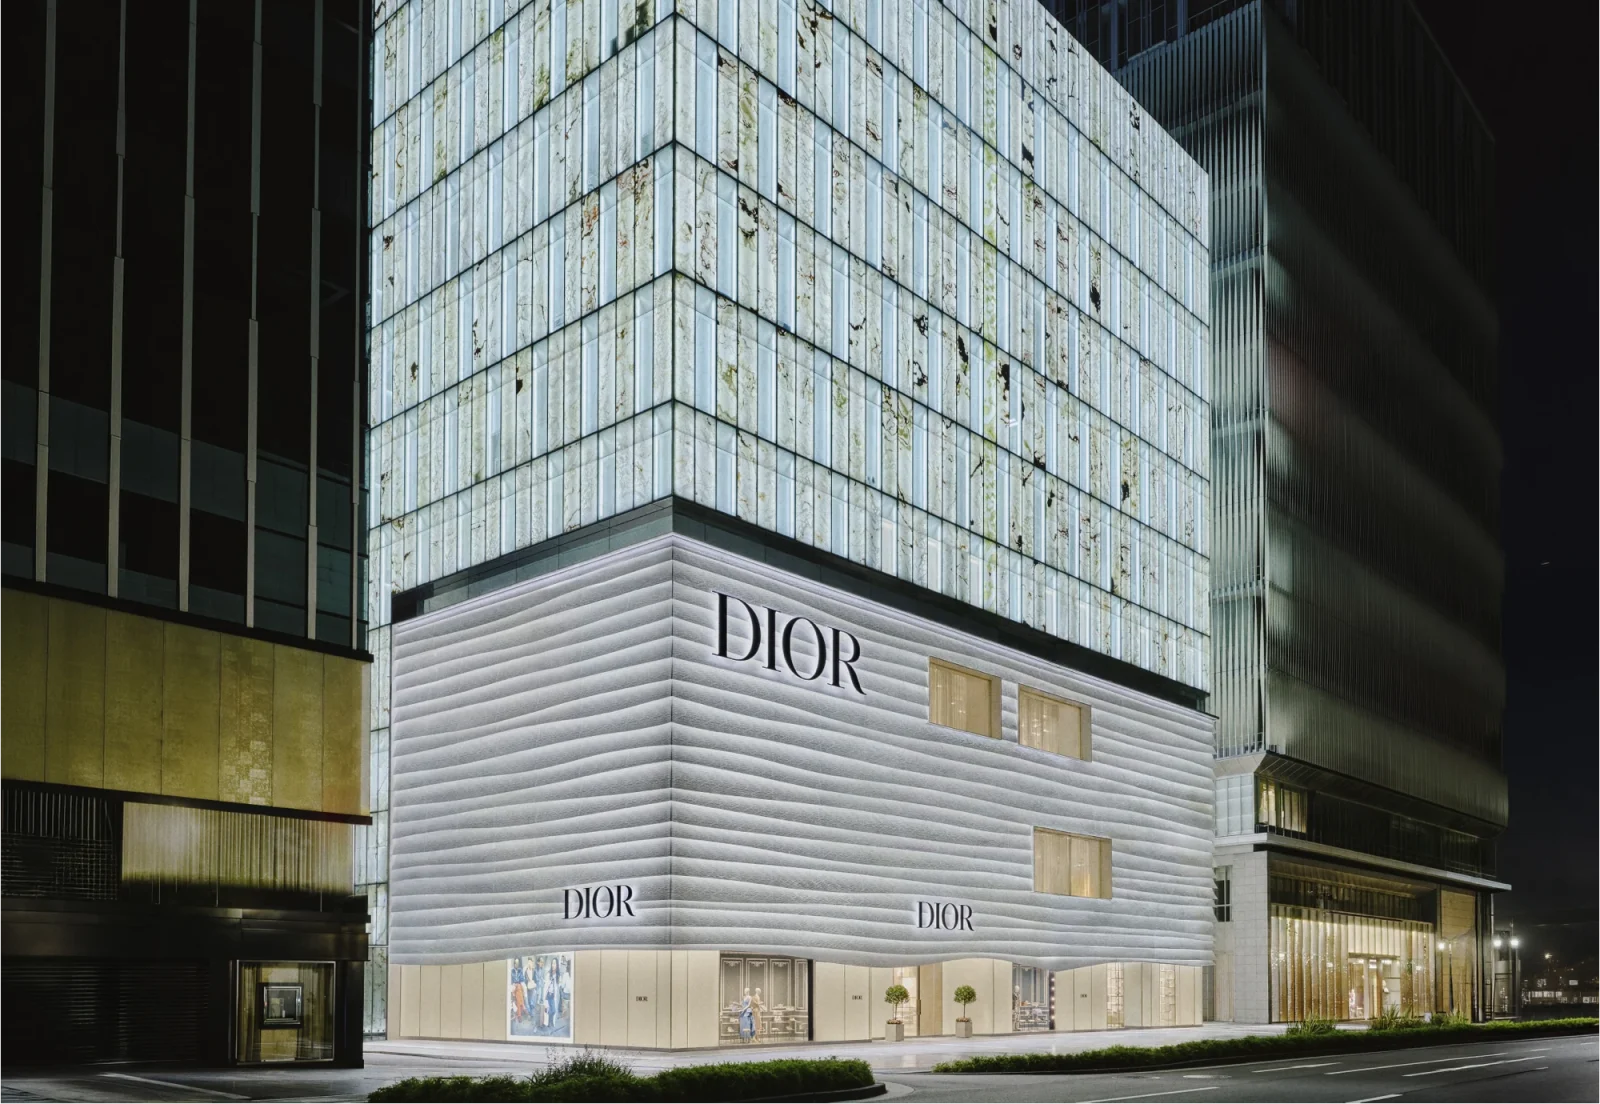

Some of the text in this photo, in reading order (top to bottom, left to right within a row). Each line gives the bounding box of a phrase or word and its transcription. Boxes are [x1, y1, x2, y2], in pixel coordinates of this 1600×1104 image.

[712, 590, 867, 696] DIOR
[562, 884, 635, 920] DIOR
[917, 901, 975, 931] DIOR
